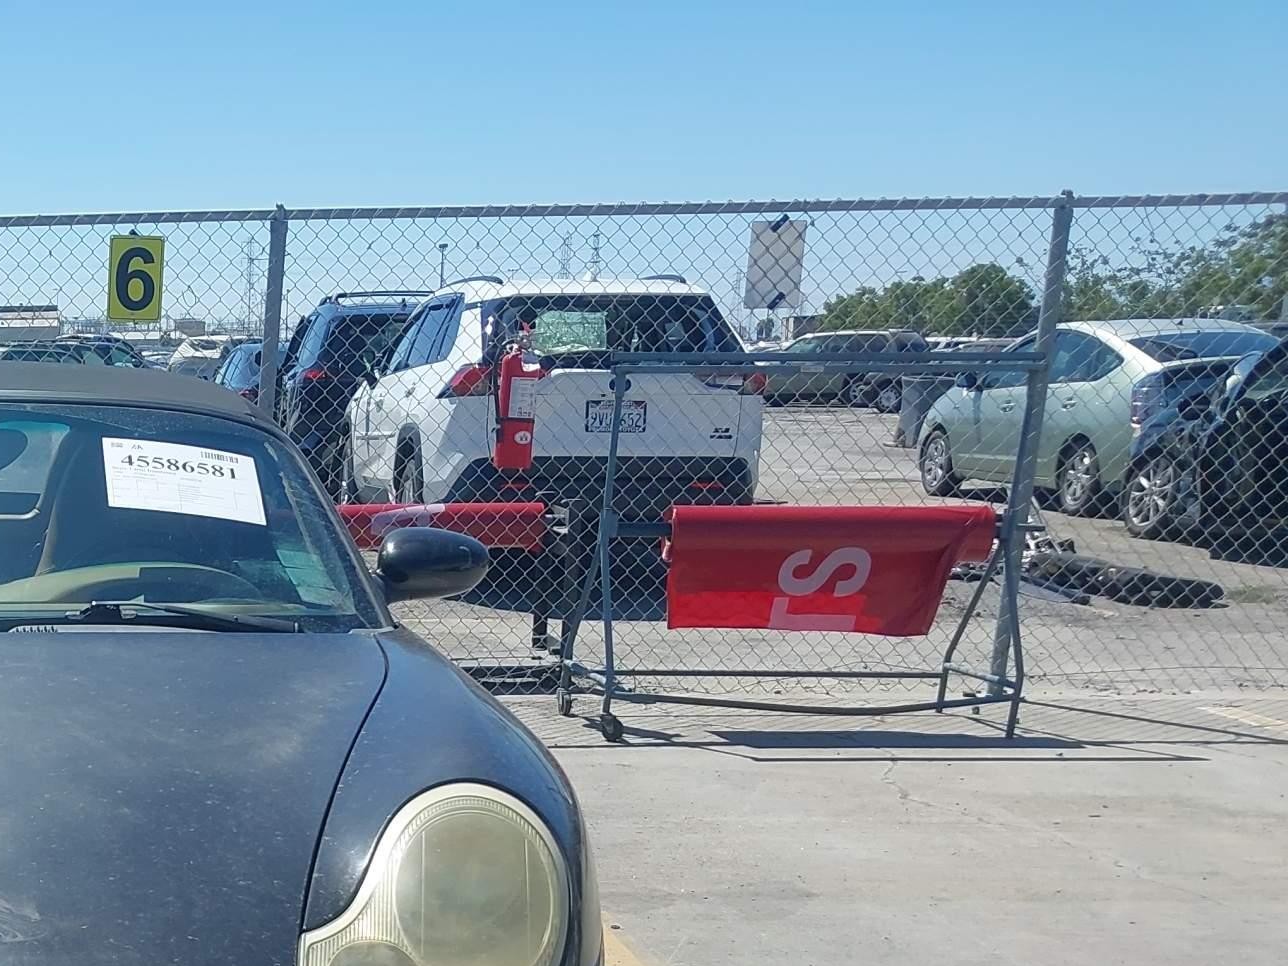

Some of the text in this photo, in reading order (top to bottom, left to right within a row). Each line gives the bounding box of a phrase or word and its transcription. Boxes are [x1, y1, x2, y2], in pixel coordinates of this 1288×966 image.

[115, 246, 156, 312] 6
[590, 412, 642, 428] 9VU652
[120, 453, 238, 480] 45586581
